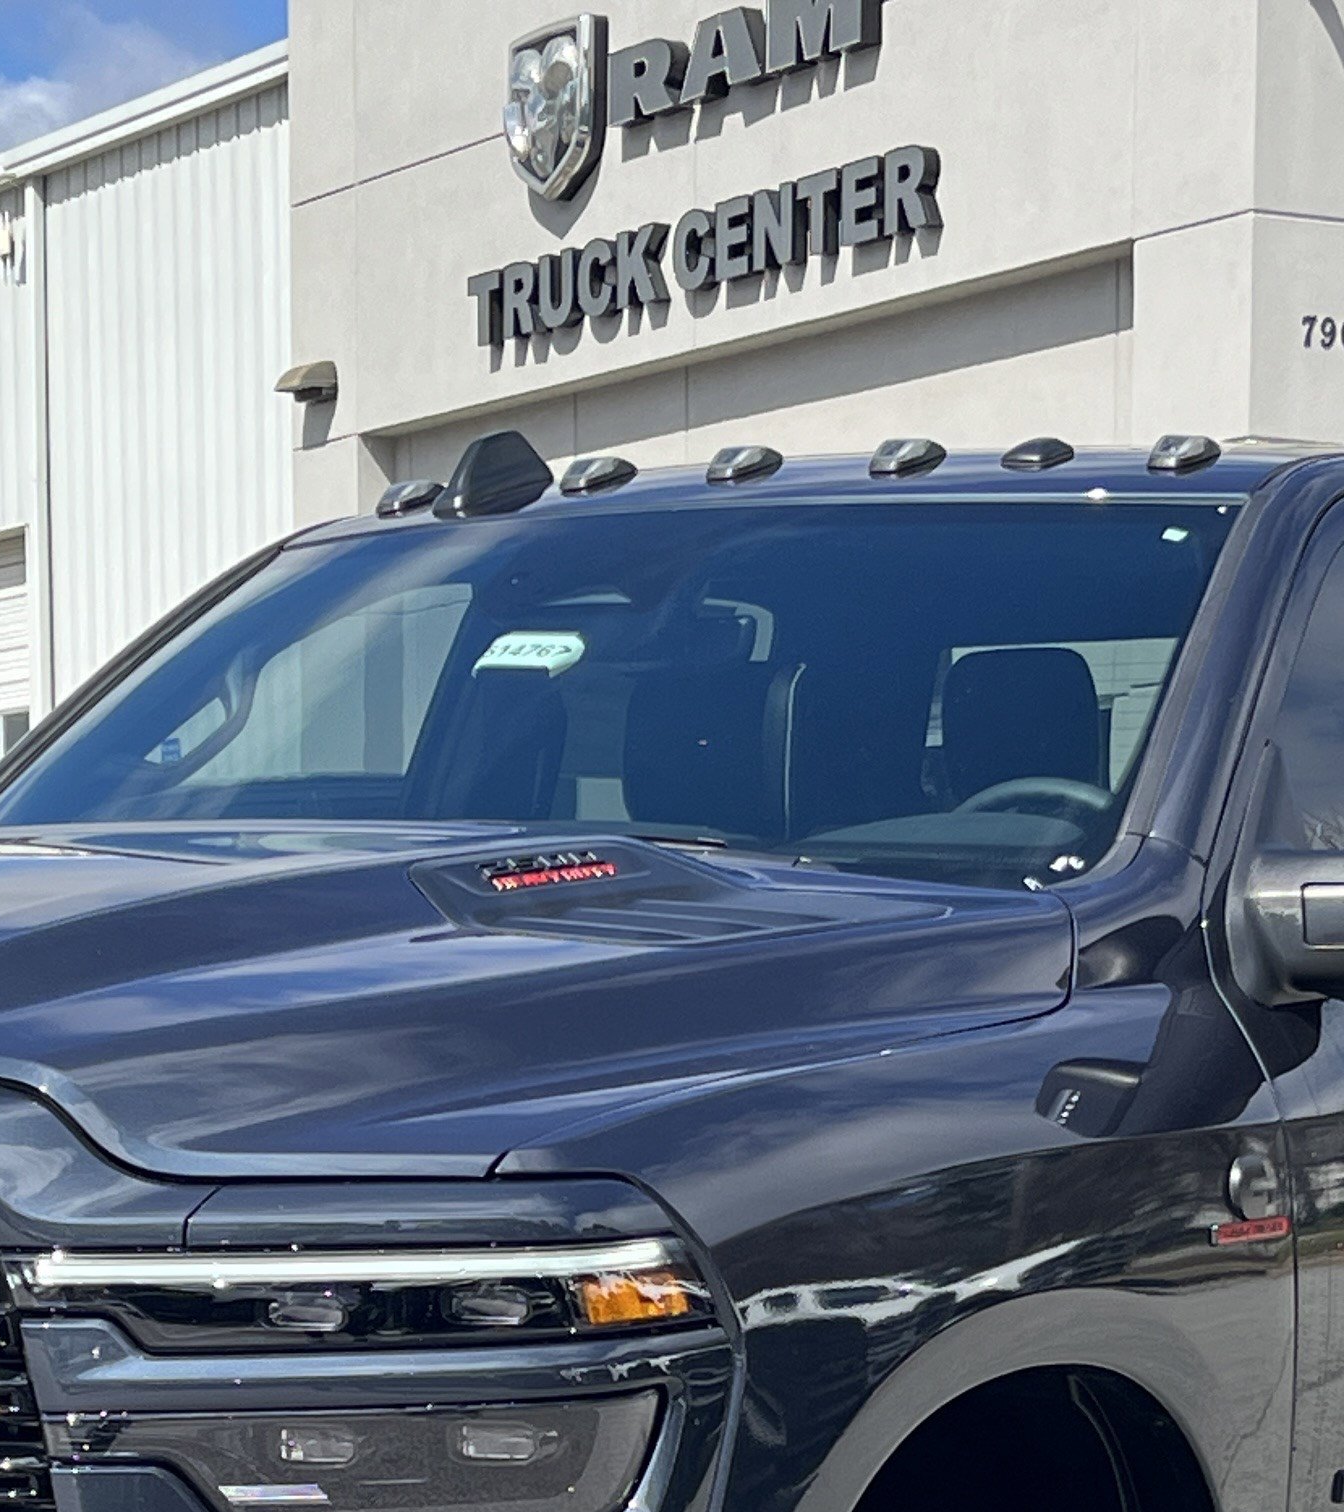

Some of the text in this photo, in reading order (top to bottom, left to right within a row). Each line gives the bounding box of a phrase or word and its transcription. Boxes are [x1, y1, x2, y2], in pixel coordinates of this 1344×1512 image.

[607, 0, 882, 127] RAM
[468, 145, 942, 348] TRUCK CENTER
